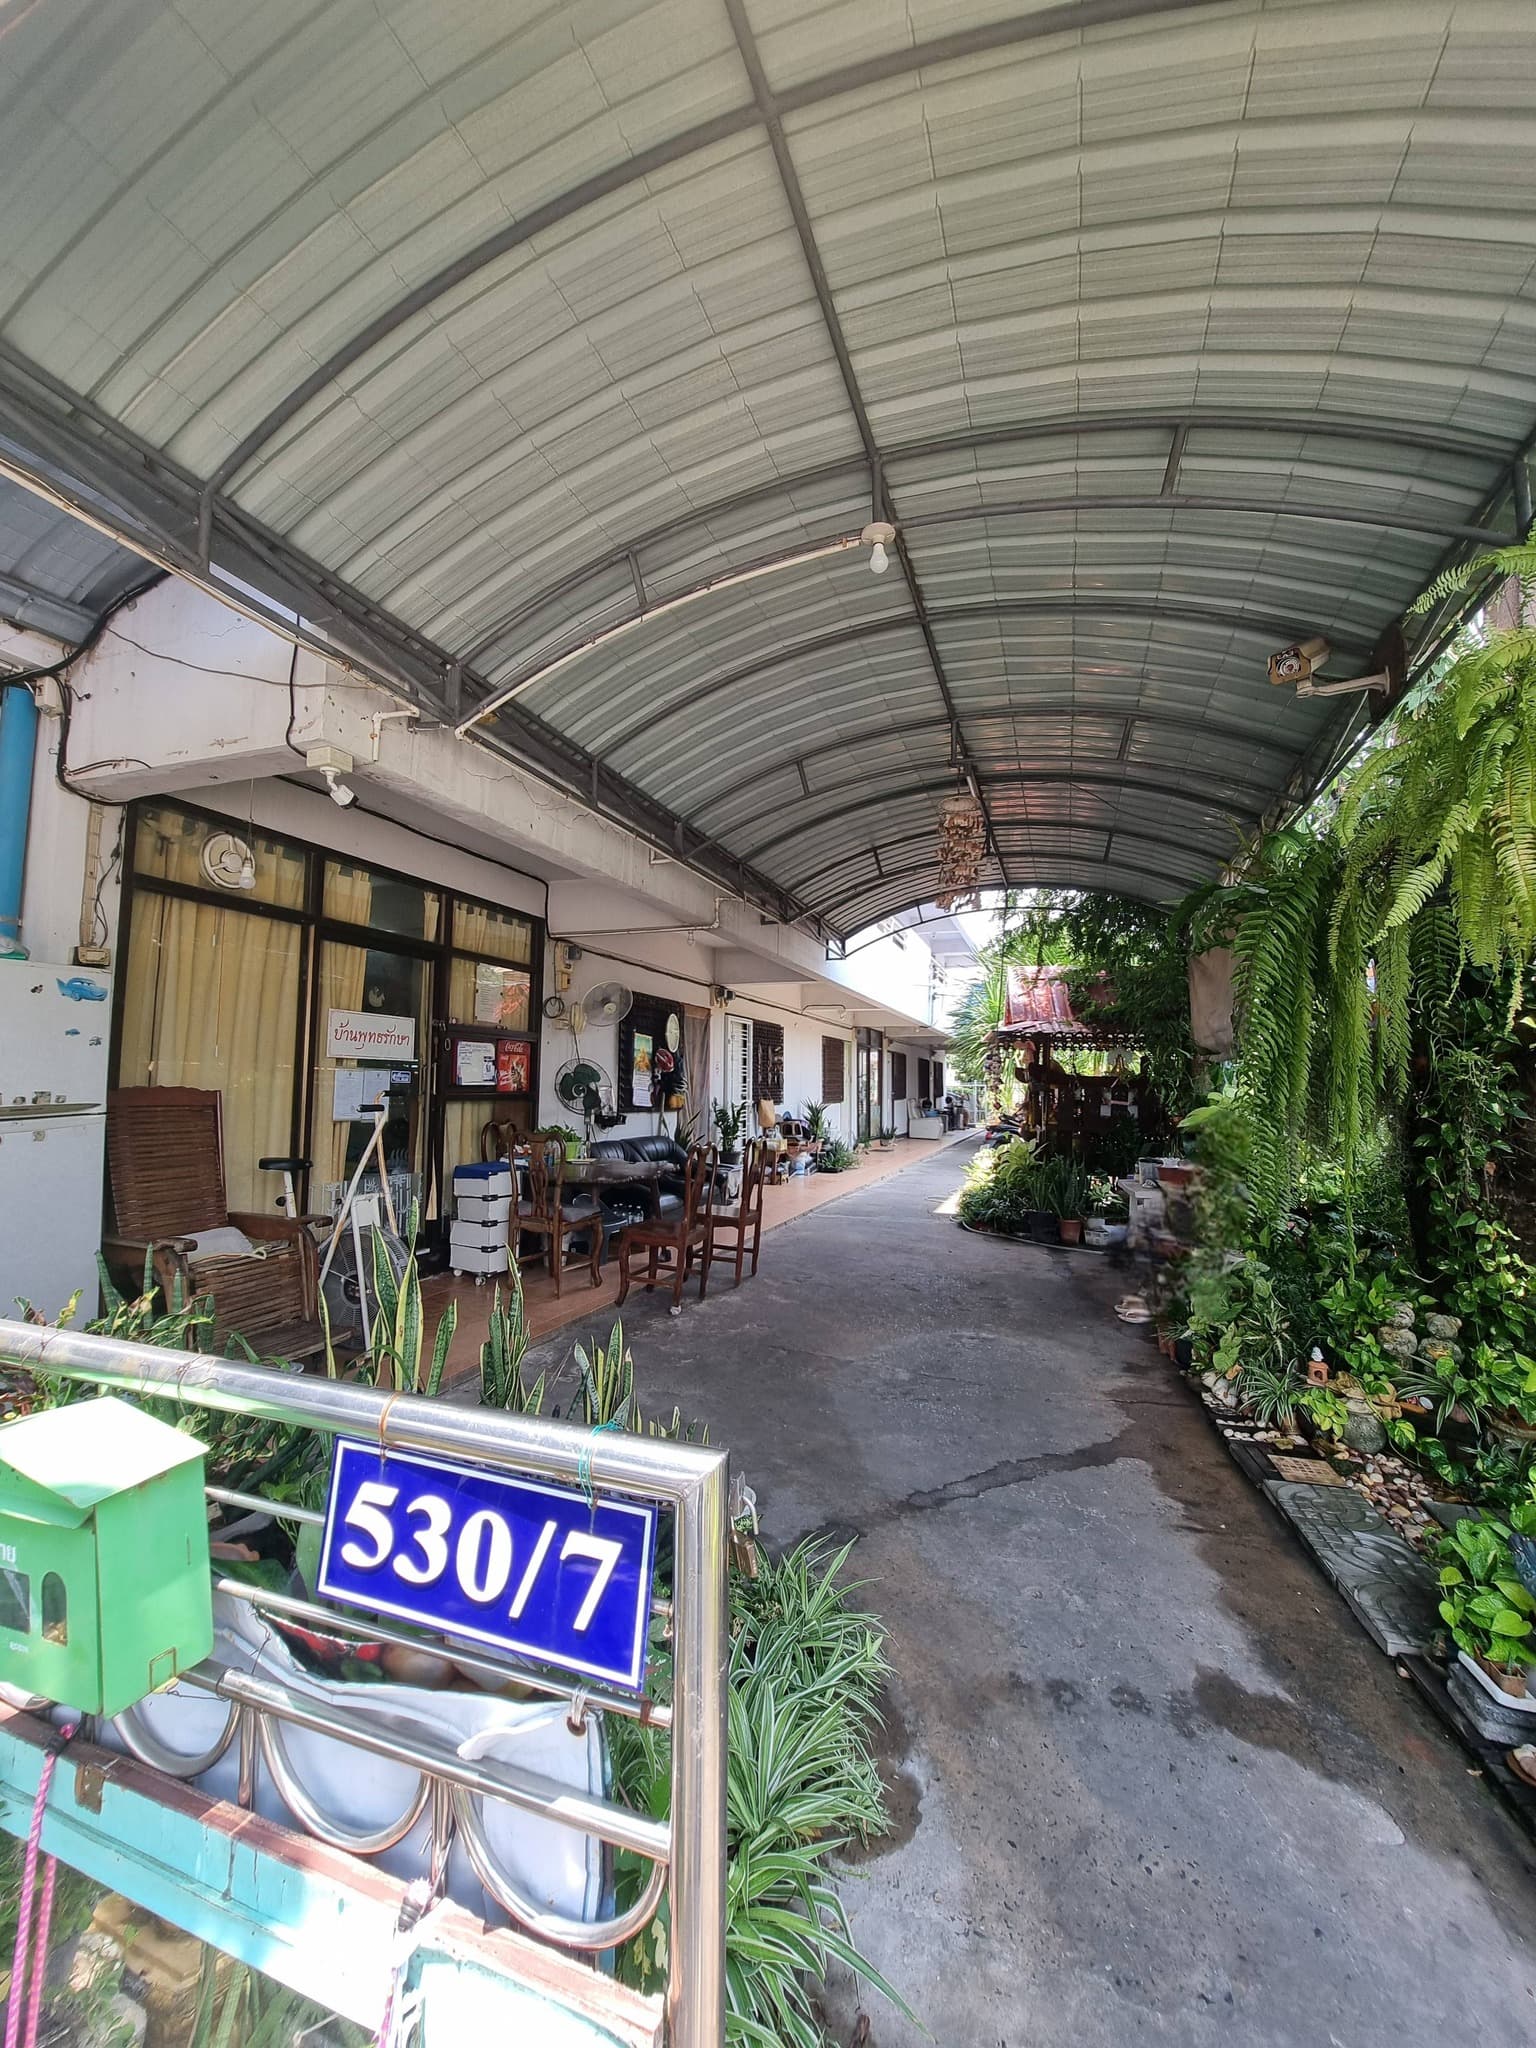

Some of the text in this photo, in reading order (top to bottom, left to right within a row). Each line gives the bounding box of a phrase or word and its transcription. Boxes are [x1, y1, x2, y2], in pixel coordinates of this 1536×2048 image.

[334, 1019, 410, 1050] บ้านพุทธรักษา
[341, 1481, 623, 1632] 530/7
